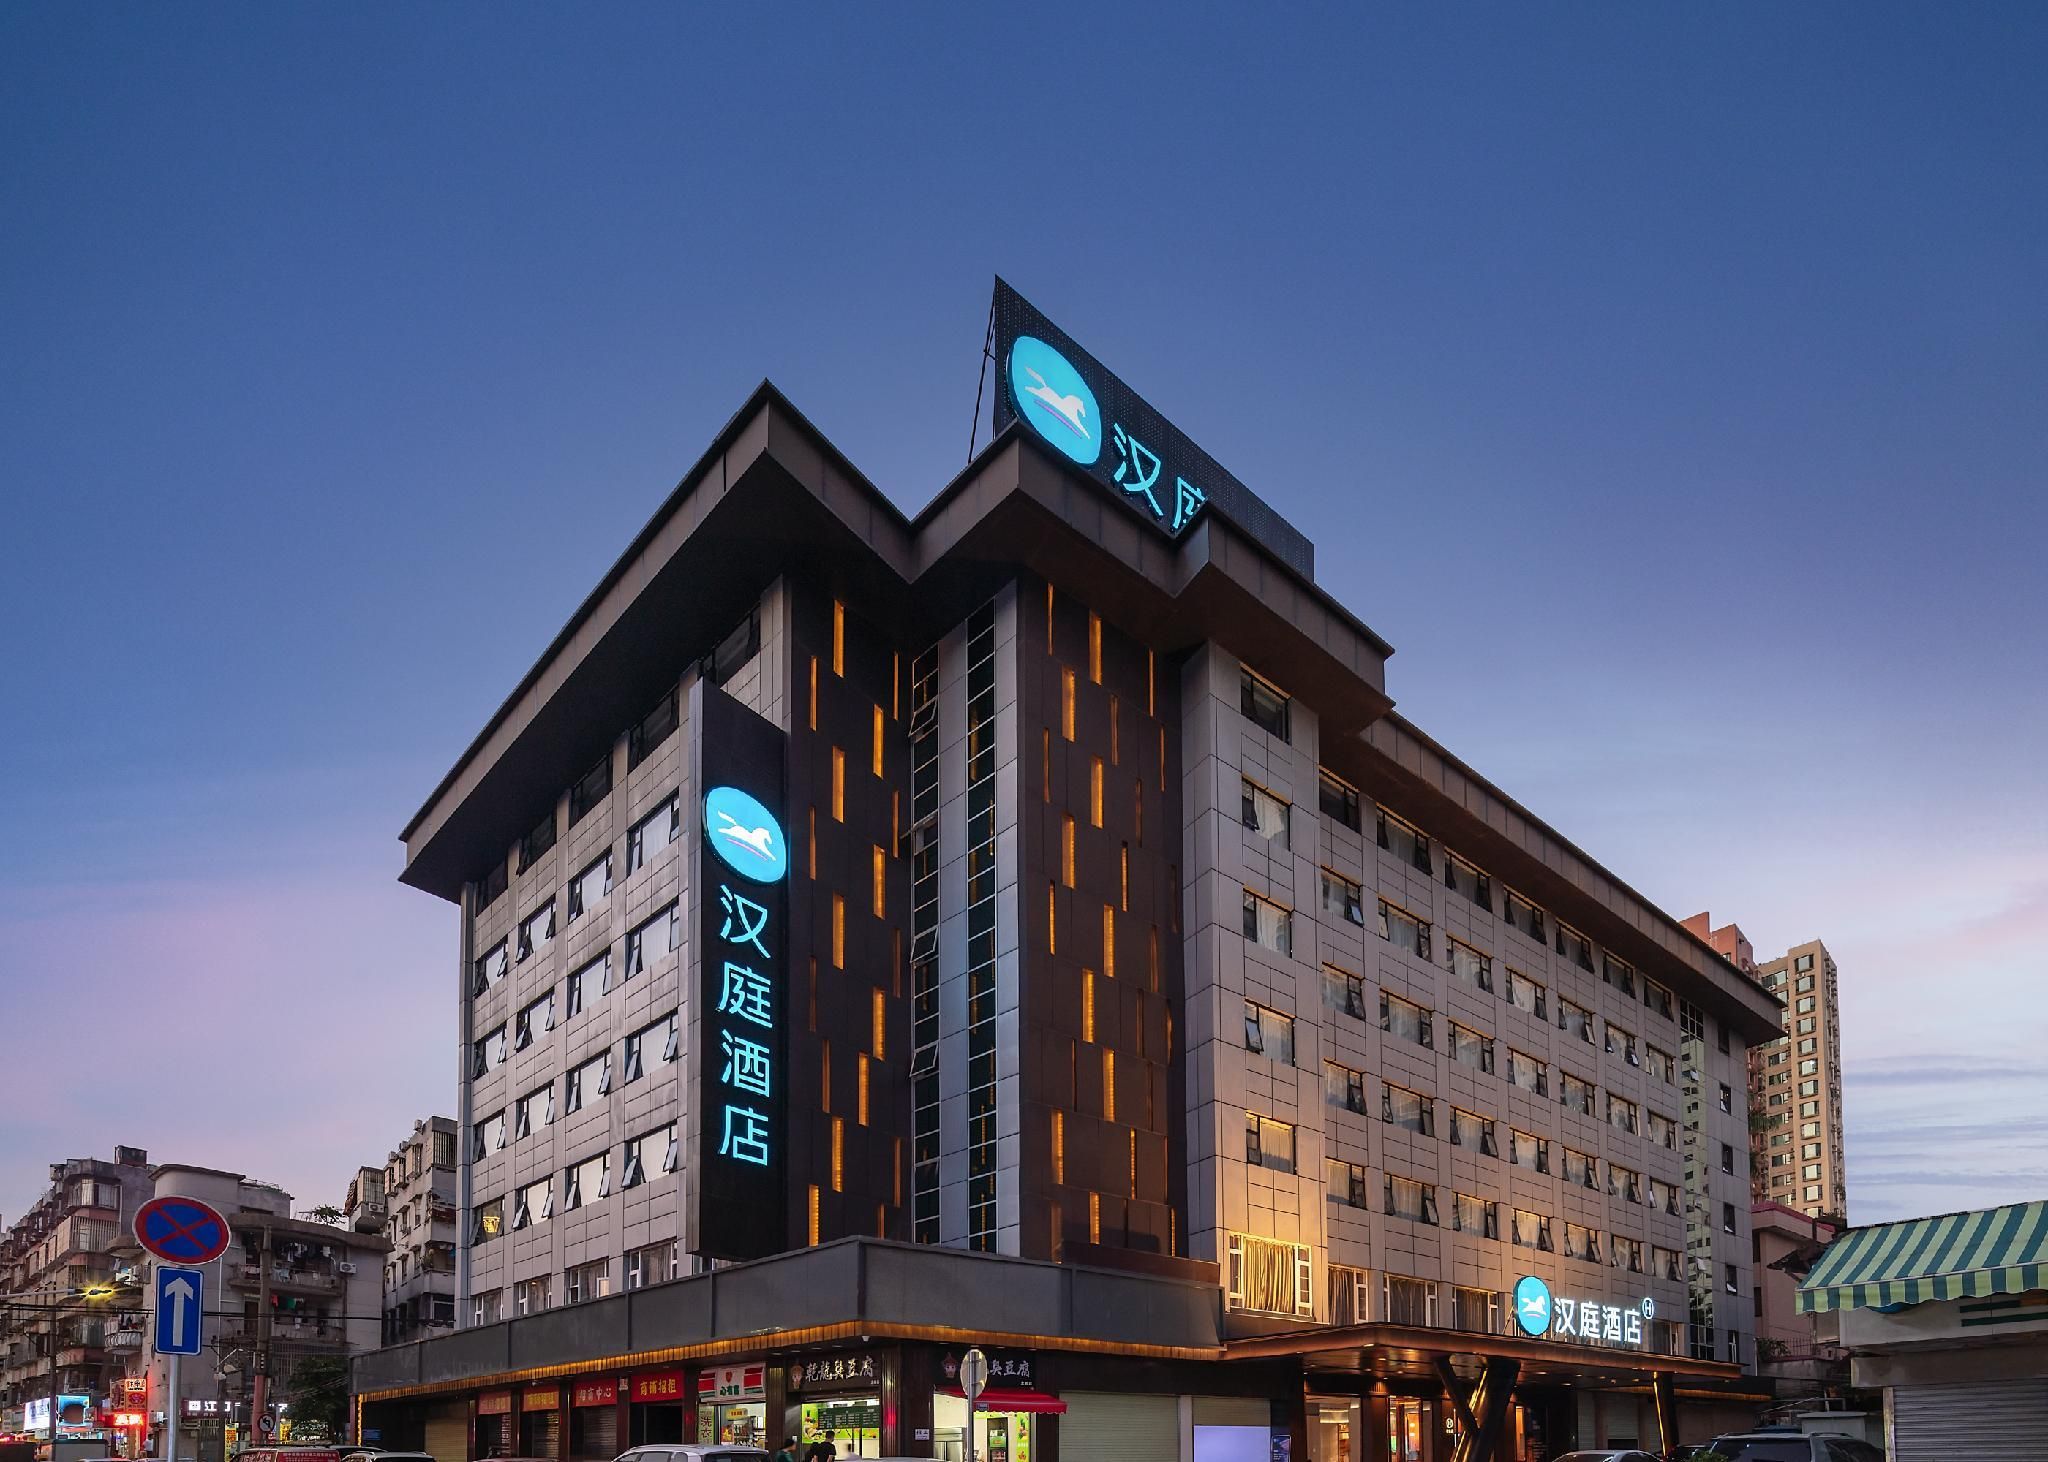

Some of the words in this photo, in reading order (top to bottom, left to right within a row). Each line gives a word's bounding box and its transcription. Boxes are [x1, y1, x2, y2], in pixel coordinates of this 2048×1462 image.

[715, 883, 773, 1166] 汉庭酒店
[1554, 1297, 1641, 1345] 汉庭酒店
[987, 1359, 1031, 1378] 臭豆腐
